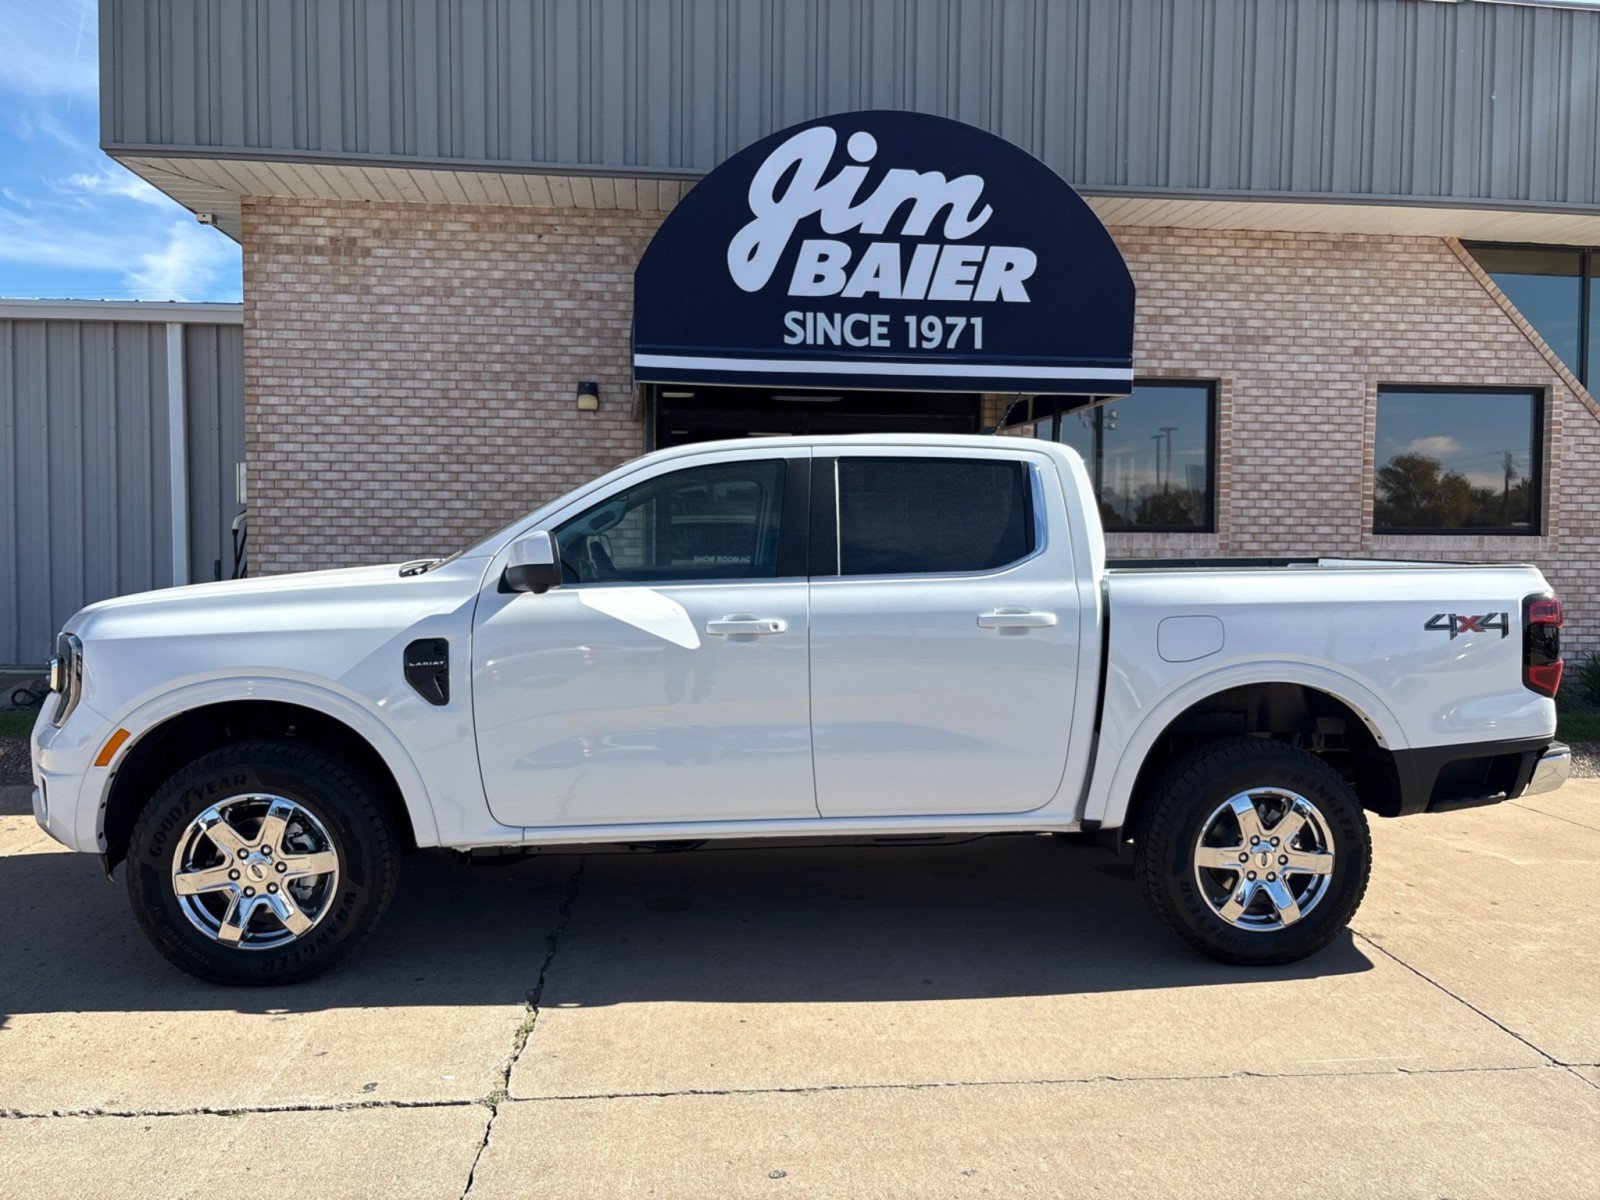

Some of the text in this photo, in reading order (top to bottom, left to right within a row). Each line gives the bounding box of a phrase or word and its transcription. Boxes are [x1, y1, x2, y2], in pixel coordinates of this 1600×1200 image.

[727, 126, 993, 292] Jim
[787, 239, 1037, 303] BAIER
[783, 311, 983, 350] SINCE 1971
[150, 774, 248, 858] GOODYEAR
[260, 891, 357, 973] WRANGLER
